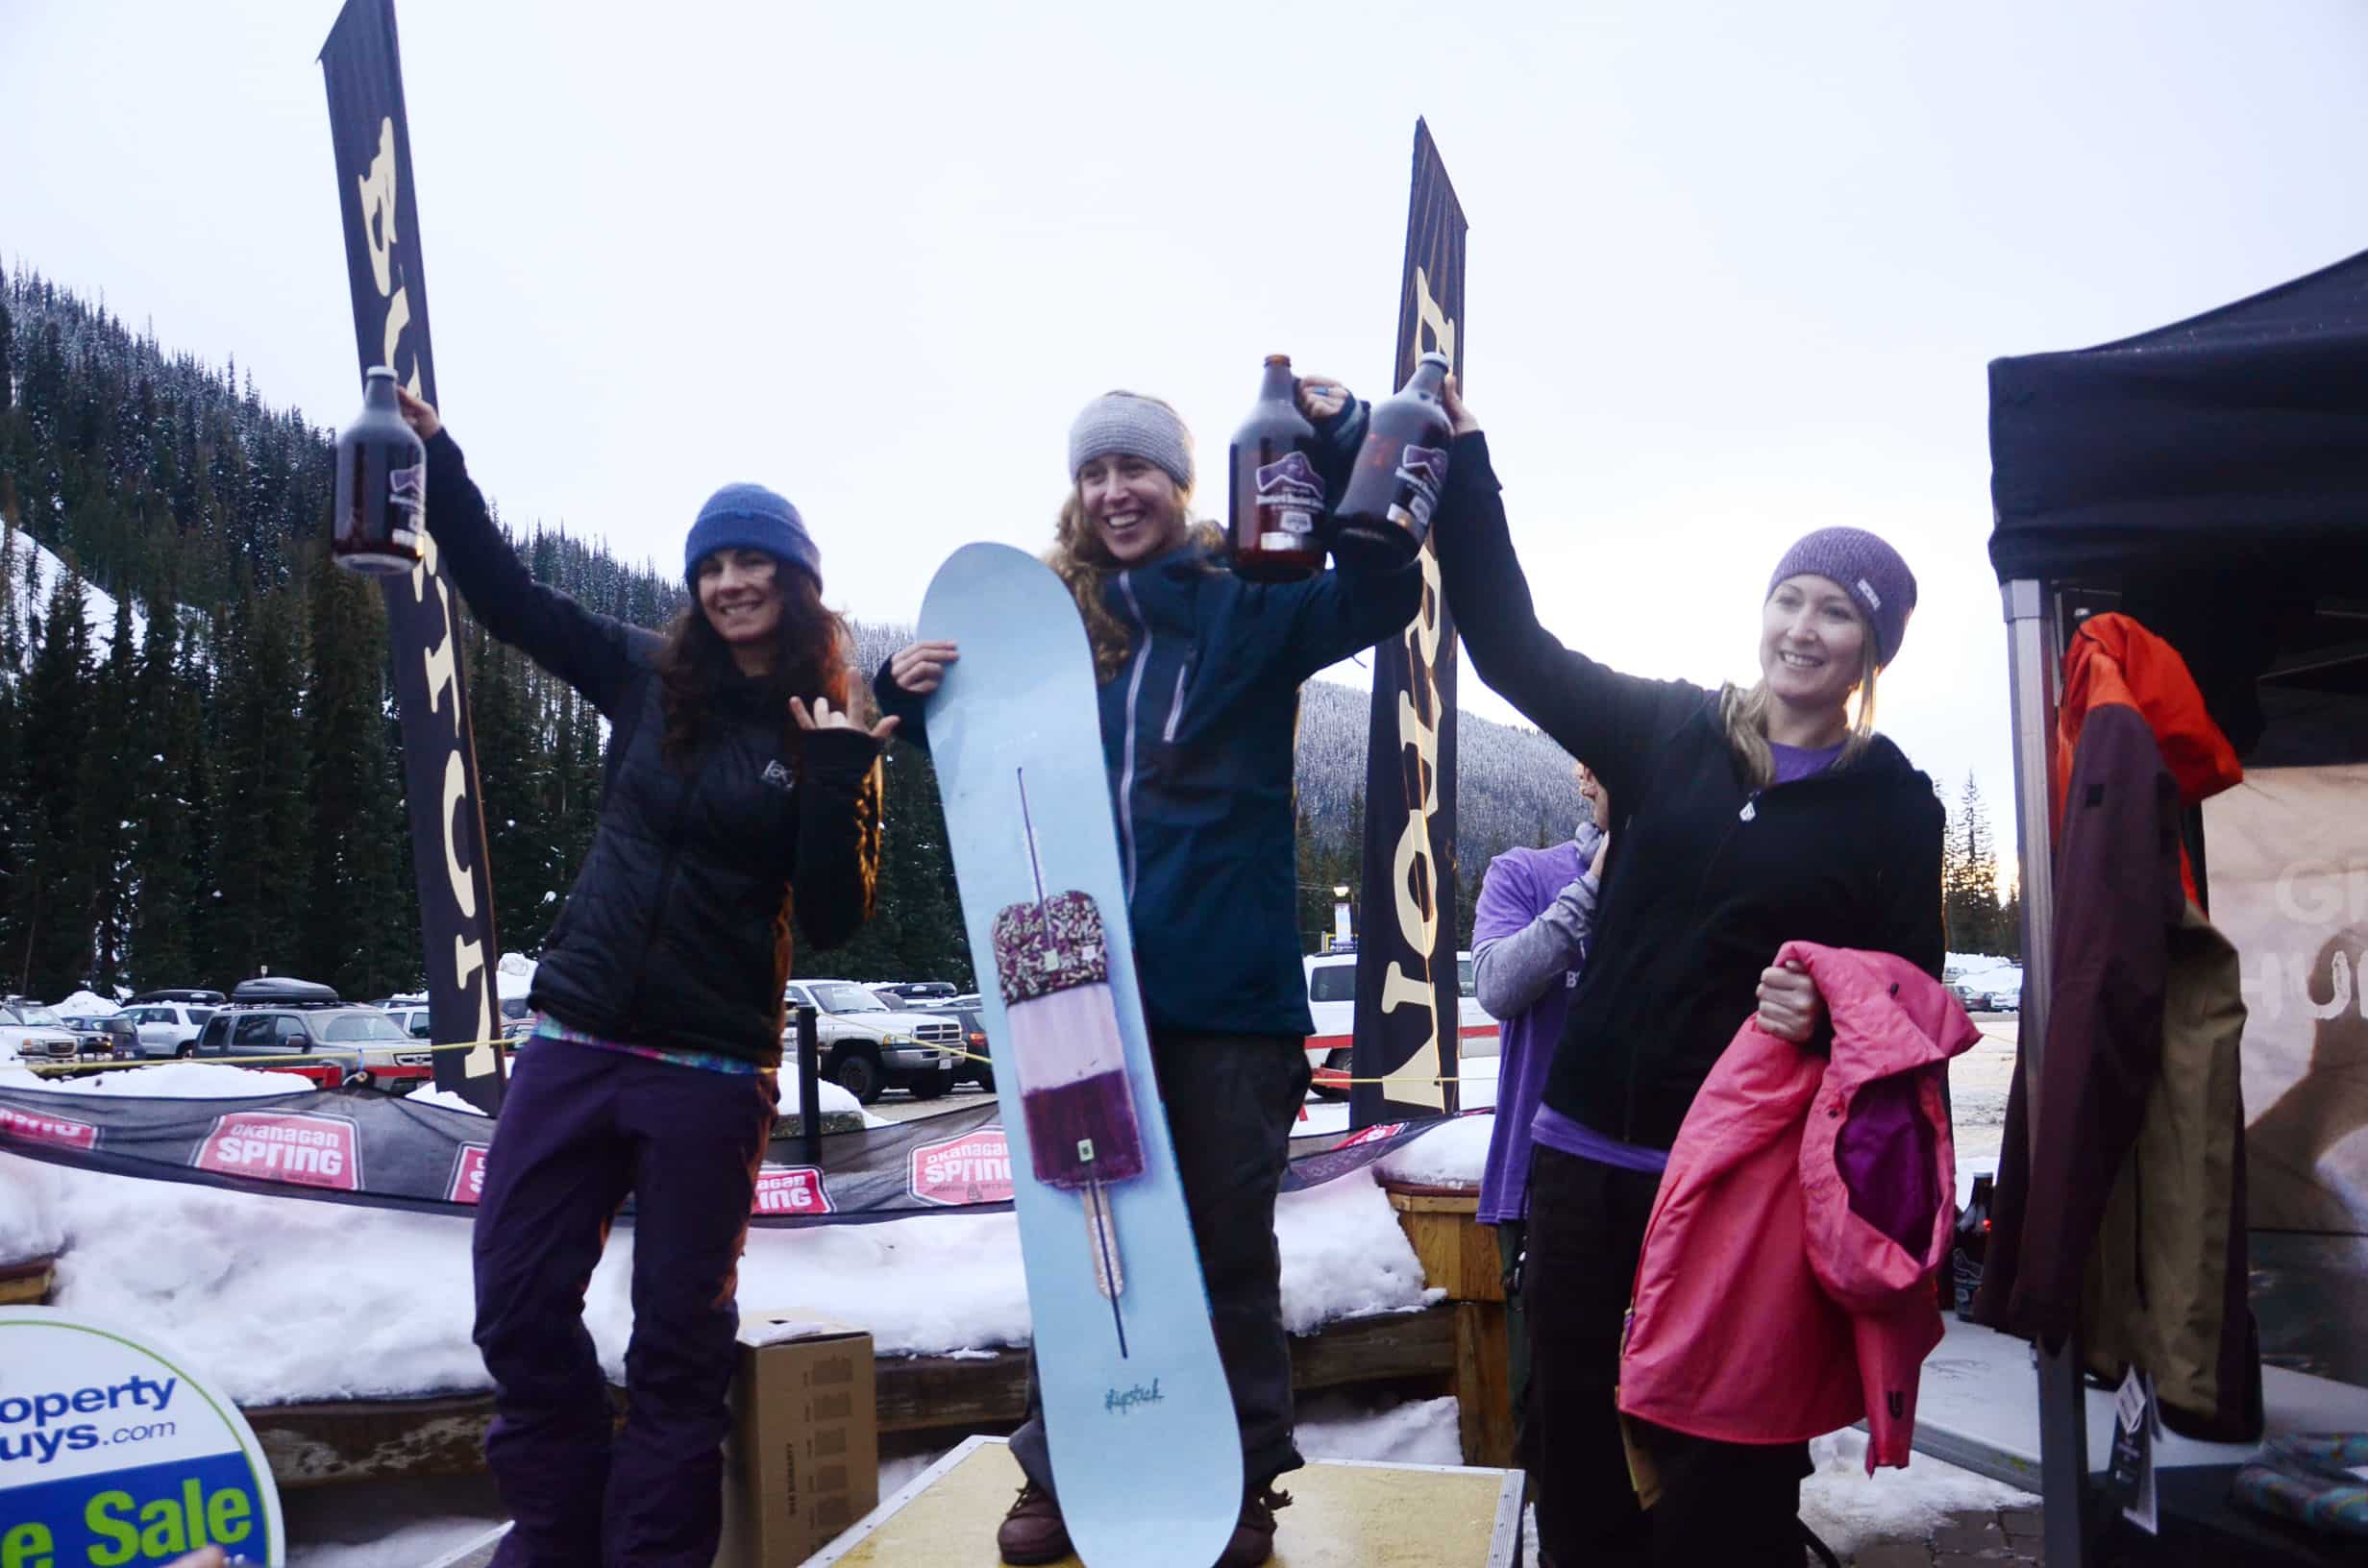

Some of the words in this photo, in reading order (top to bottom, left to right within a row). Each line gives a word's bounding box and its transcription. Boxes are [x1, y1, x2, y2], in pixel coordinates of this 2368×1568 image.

[1382, 266, 1455, 1113] BRTON
[0, 1375, 177, 1427] operty
[0, 1421, 176, 1463] uys.com
[2, 1522, 54, 1568] e
[85, 1477, 252, 1567] Sale
